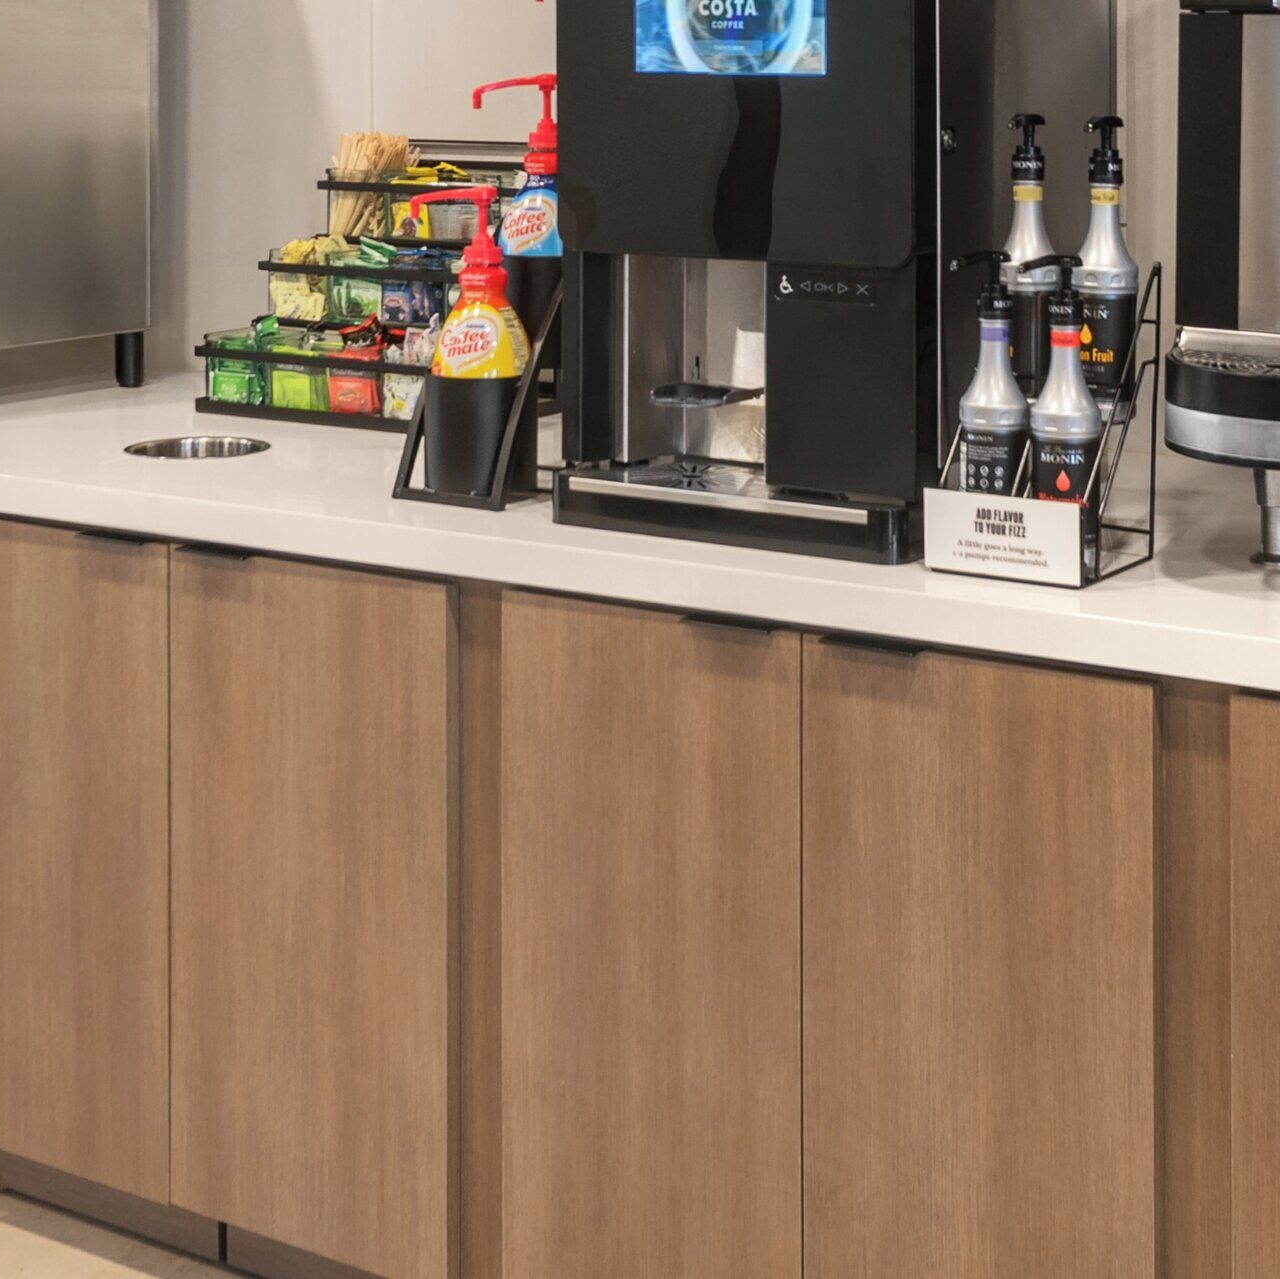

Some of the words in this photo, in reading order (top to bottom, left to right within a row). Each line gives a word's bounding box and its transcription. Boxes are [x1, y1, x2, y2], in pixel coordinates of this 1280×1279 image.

[711, 20, 745, 30] COFFEE
[503, 211, 546, 231] Coffee
[507, 221, 547, 239] mate
[814, 282, 834, 293] OK
[447, 340, 490, 358] mate
[1092, 347, 1114, 363] Fruit
[1040, 452, 1085, 465] MONIN
[976, 507, 992, 521] ADD
[993, 509, 1024, 524] FLAVOR
[974, 521, 984, 534] TO
[985, 522, 1007, 536] YOUR
[1008, 525, 1026, 538] FIZZ
[957, 539, 963, 547] A
[964, 539, 982, 549] little
[984, 543, 1001, 552] goes
[1008, 544, 1026, 556] long
[964, 551, 991, 562] pumps
